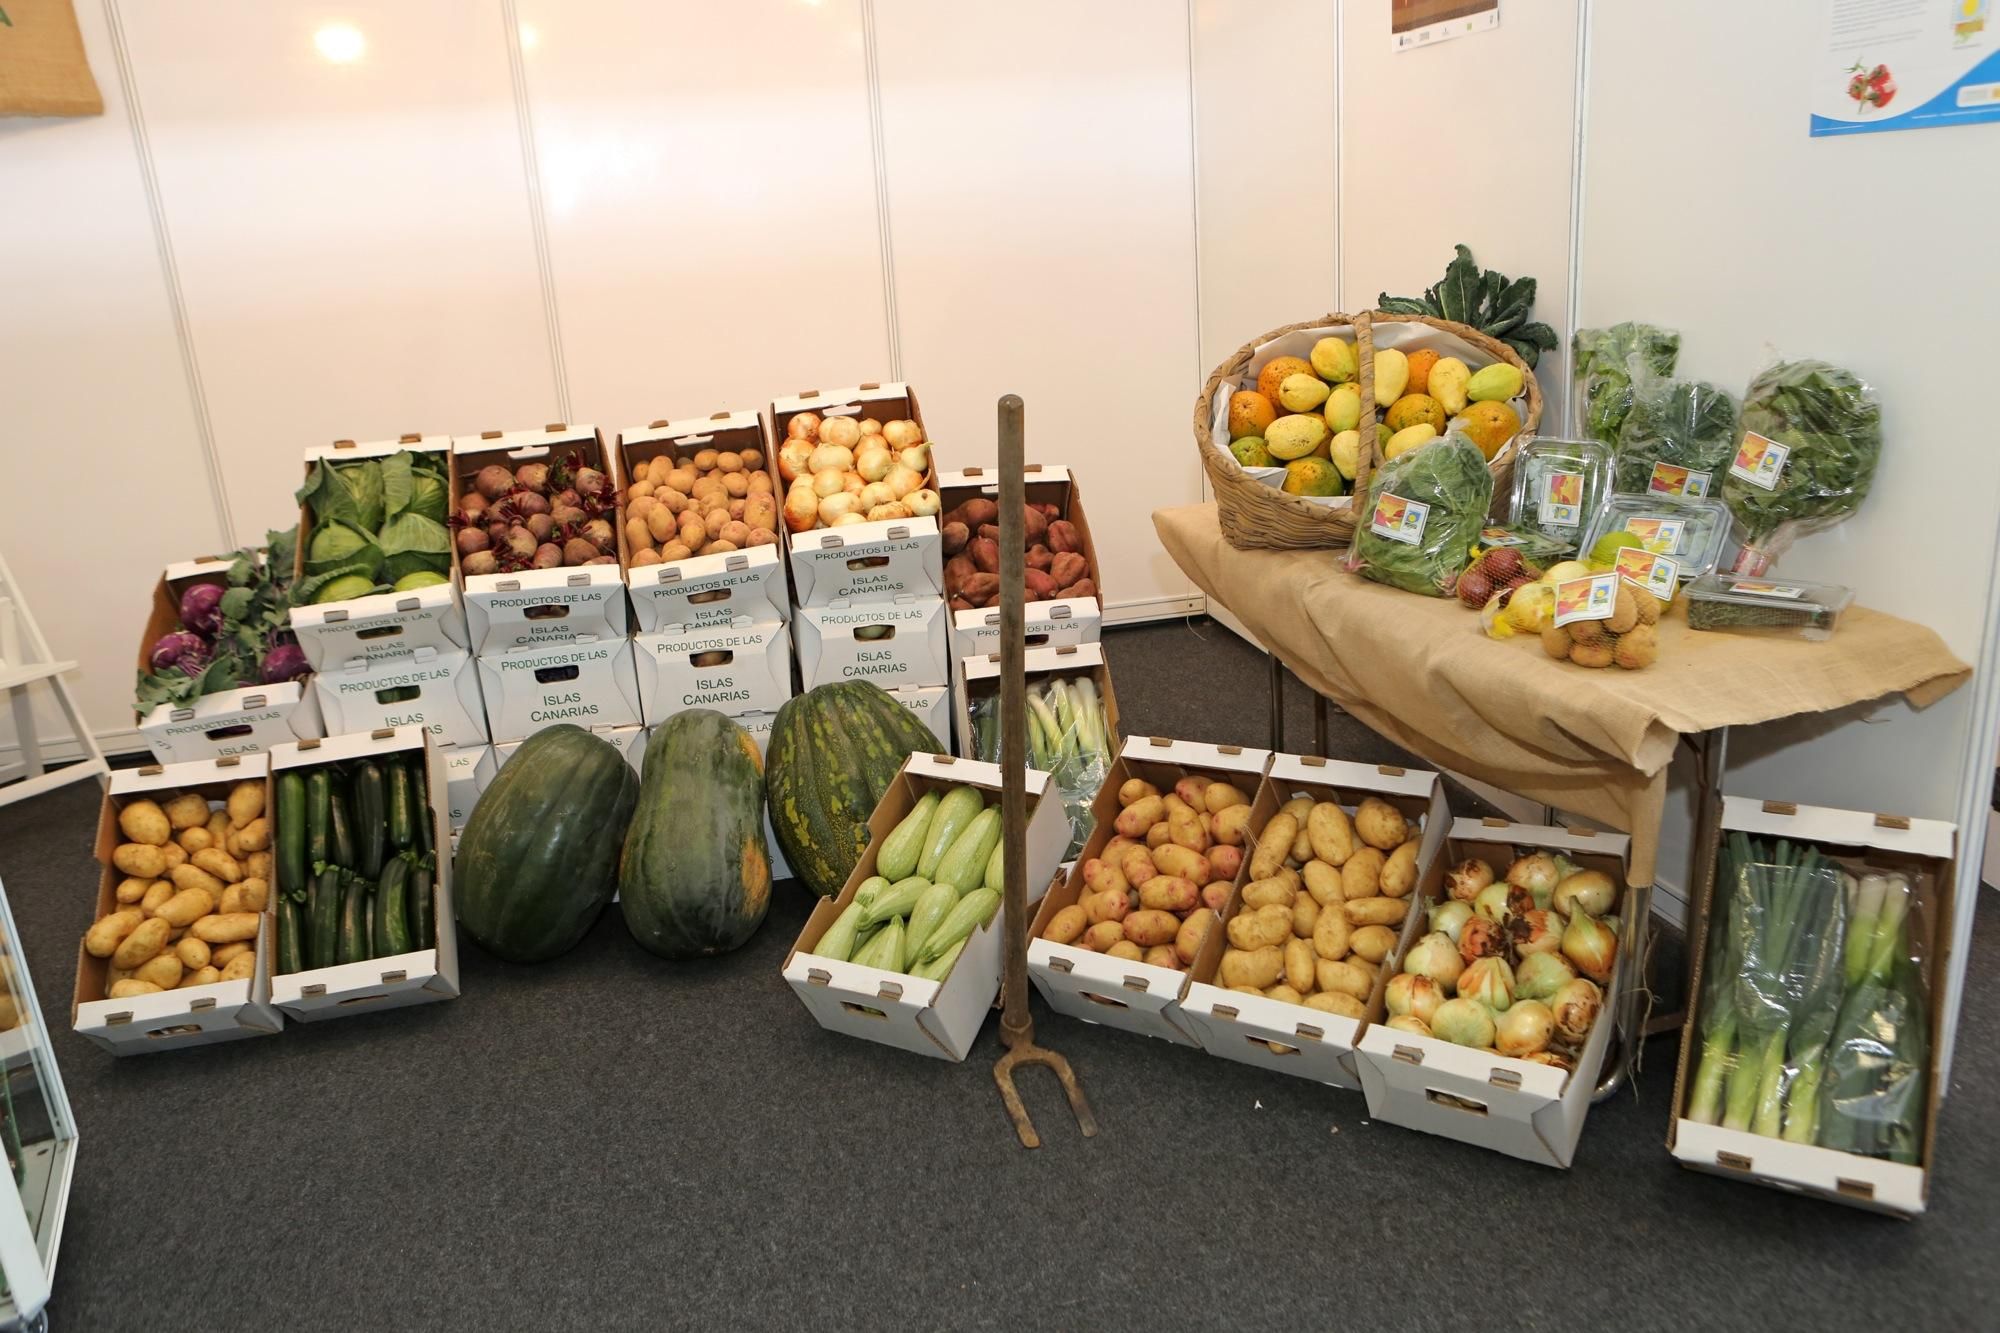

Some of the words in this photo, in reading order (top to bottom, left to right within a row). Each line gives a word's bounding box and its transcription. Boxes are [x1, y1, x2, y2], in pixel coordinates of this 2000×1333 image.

[815, 546, 881, 561] PRODUCTOS
[884, 544, 897, 552] DE
[900, 541, 920, 549] LAS
[653, 580, 721, 598] PRODUCTOS
[723, 577, 738, 586] DE
[739, 574, 760, 583] LAS
[852, 574, 889, 585] ISLAS
[838, 582, 904, 597] CANARIAS
[490, 595, 562, 609] PRODUCTOS
[563, 594, 580, 603] DE
[581, 592, 602, 601] LAS
[695, 608, 733, 620] ISLAS
[821, 612, 886, 625] PRODUCTOS
[887, 611, 902, 620] DE
[904, 609, 923, 618] LAS
[318, 617, 391, 635] PRODUCTOS
[396, 615, 411, 624] DE
[411, 612, 433, 622] LAS
[530, 625, 569, 634] ISLAS
[683, 617, 733, 630] CANARI
[977, 625, 1042, 637] PROOS
[1043, 623, 1058, 632] DE
[1060, 622, 1079, 630] LAS
[516, 632, 585, 644] CANARIA
[657, 639, 723, 654] PRODUCTOS
[726, 637, 741, 646] DE
[742, 634, 763, 644] LAS
[365, 641, 406, 652] ISLAS
[501, 654, 568, 671] PRODUCTOS
[570, 653, 587, 663] DE
[588, 650, 608, 659] LAS
[857, 650, 892, 662] ISLAS
[843, 663, 907, 677] CANARIAS
[340, 674, 409, 693] PRODUCTOS
[412, 672, 428, 682] DE
[429, 668, 450, 680] LAS
[696, 677, 733, 690] ISLAS
[543, 692, 581, 706] ISLAS
[682, 690, 750, 706] CANARIAS
[909, 699, 929, 709] LAS
[384, 712, 424, 728] ISLAS
[530, 704, 599, 722] CANARIAS
[166, 719, 239, 736] PRODUCTOS
[240, 715, 257, 725] DE
[258, 711, 281, 721] LAS
[217, 743, 260, 756] ISLAS
[449, 757, 470, 768] LAS
